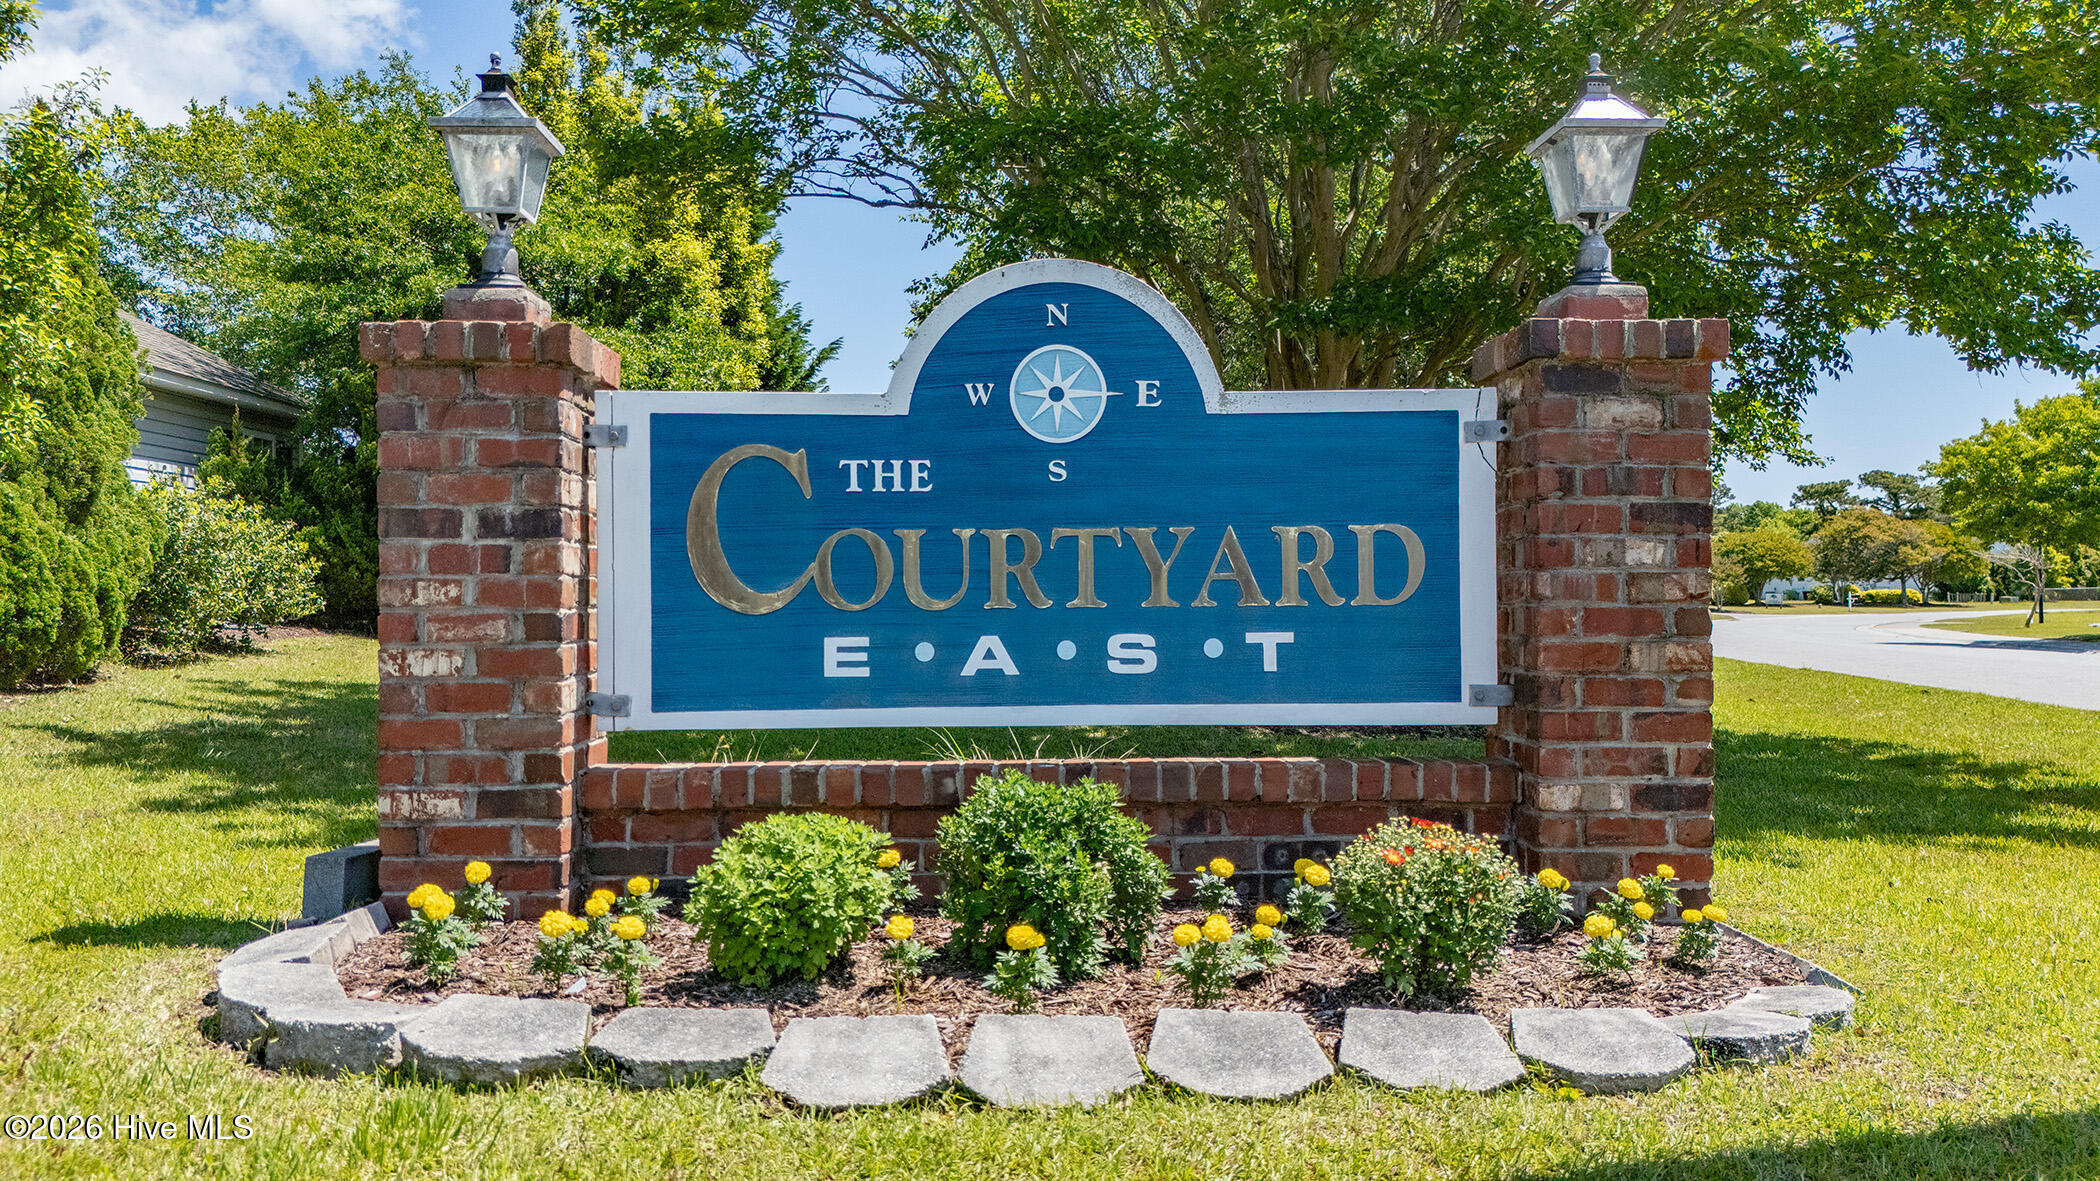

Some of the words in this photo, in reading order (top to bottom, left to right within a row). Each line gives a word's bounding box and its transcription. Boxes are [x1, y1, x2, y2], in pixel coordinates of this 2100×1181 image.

[1045, 303, 1069, 326] N
[964, 383, 995, 406] W
[1135, 381, 1162, 407] E
[838, 459, 933, 493] THE
[1048, 460, 1068, 482] S
